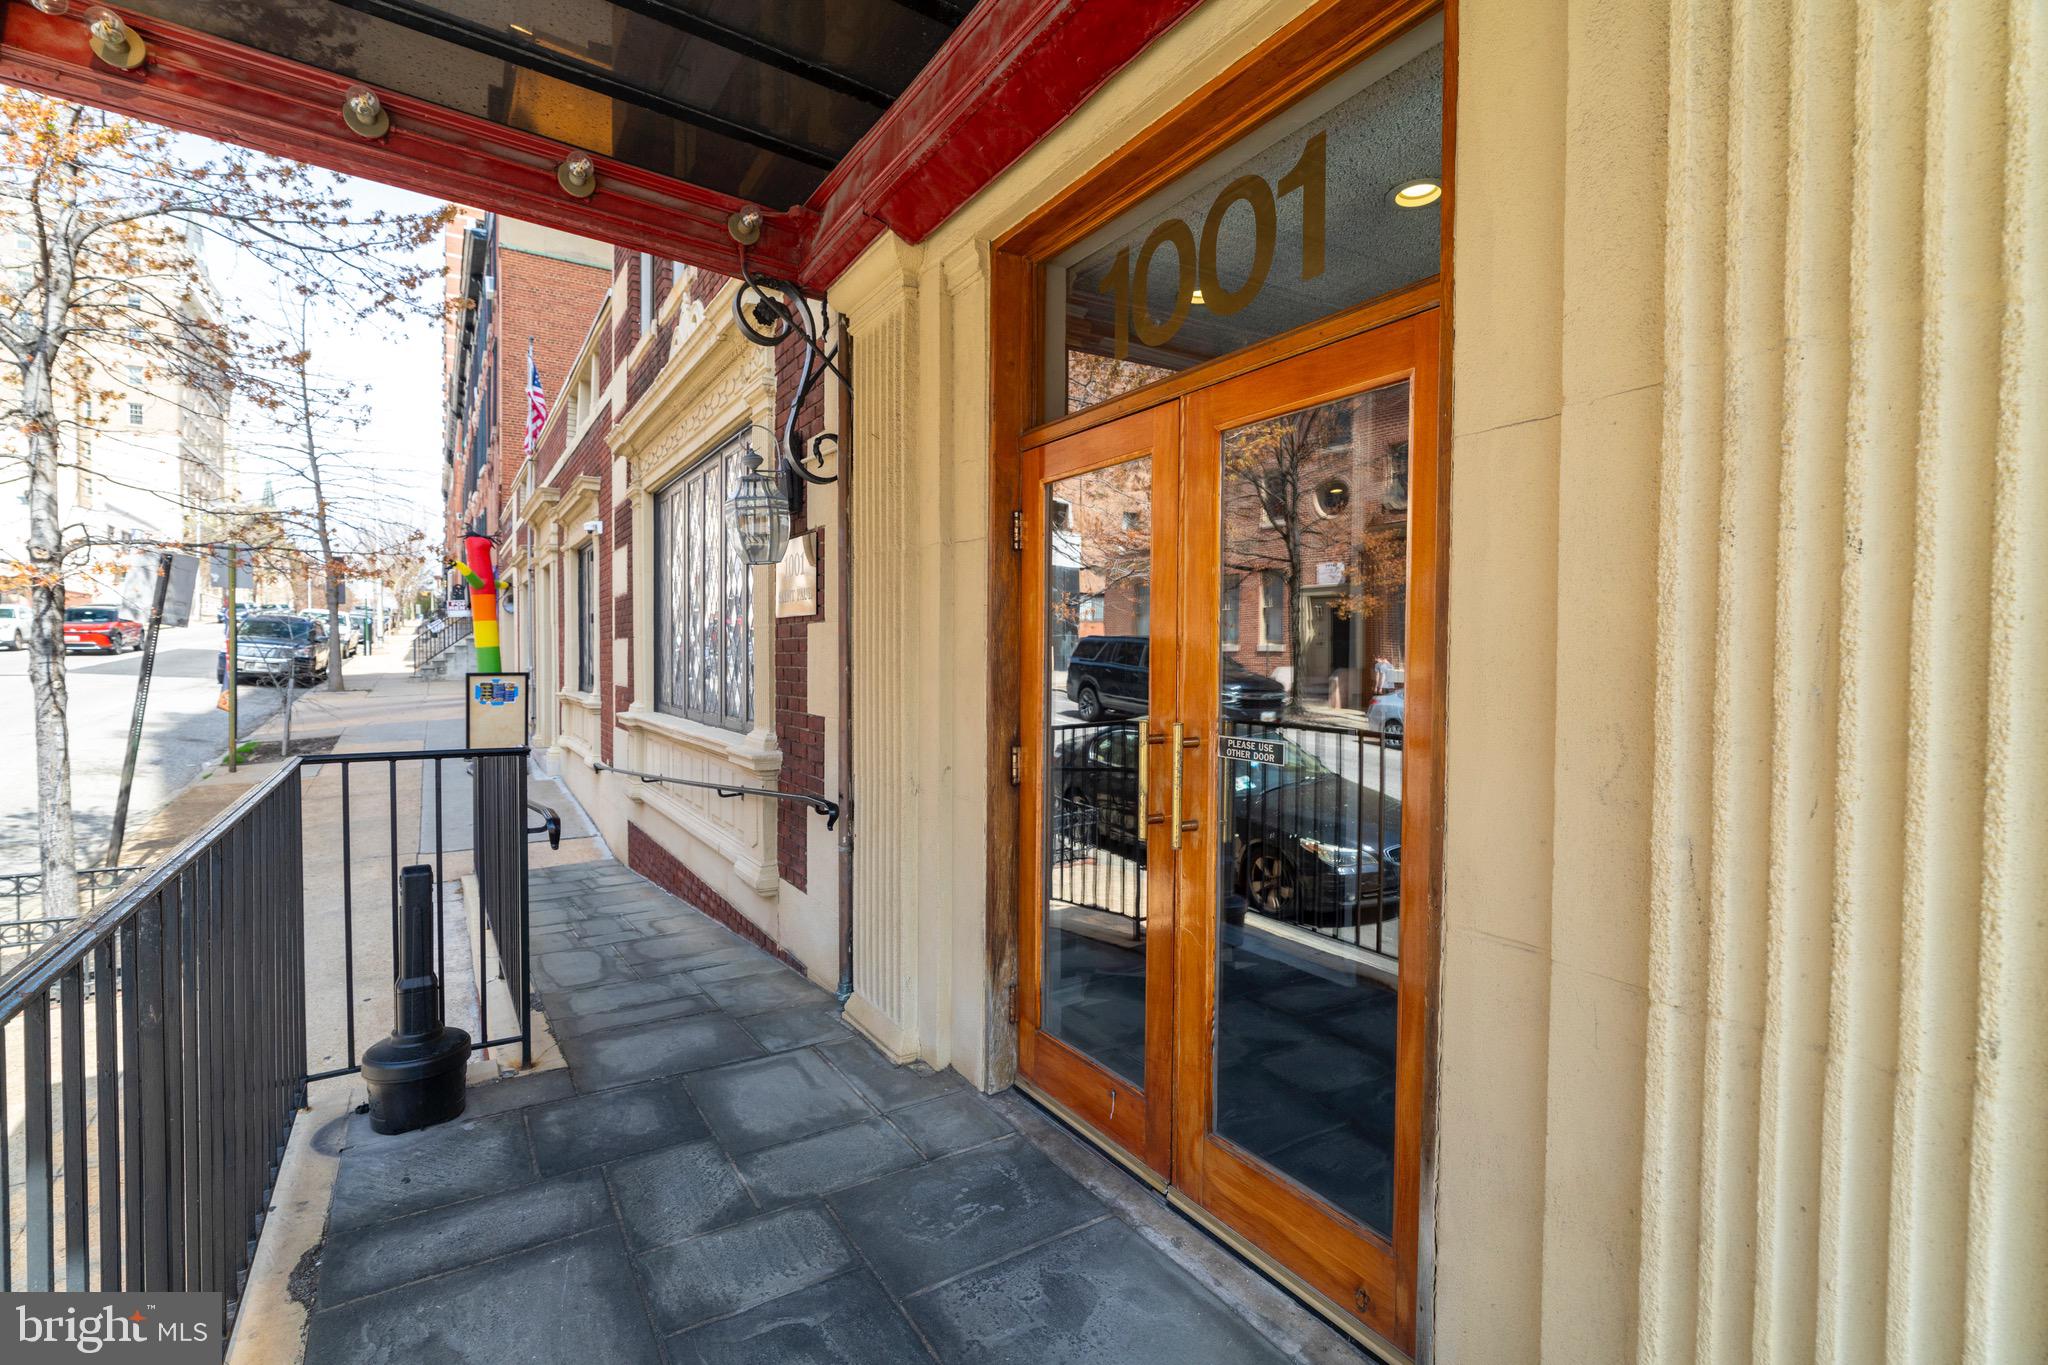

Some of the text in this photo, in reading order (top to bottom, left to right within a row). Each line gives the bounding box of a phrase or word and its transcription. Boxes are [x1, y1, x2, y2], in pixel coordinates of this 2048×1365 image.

[1098, 129, 1327, 361] 1001
[784, 552, 805, 579] 1001
[1226, 748, 1275, 763] OTHER DOOR
[1227, 739, 1274, 753] PLEASE USE
